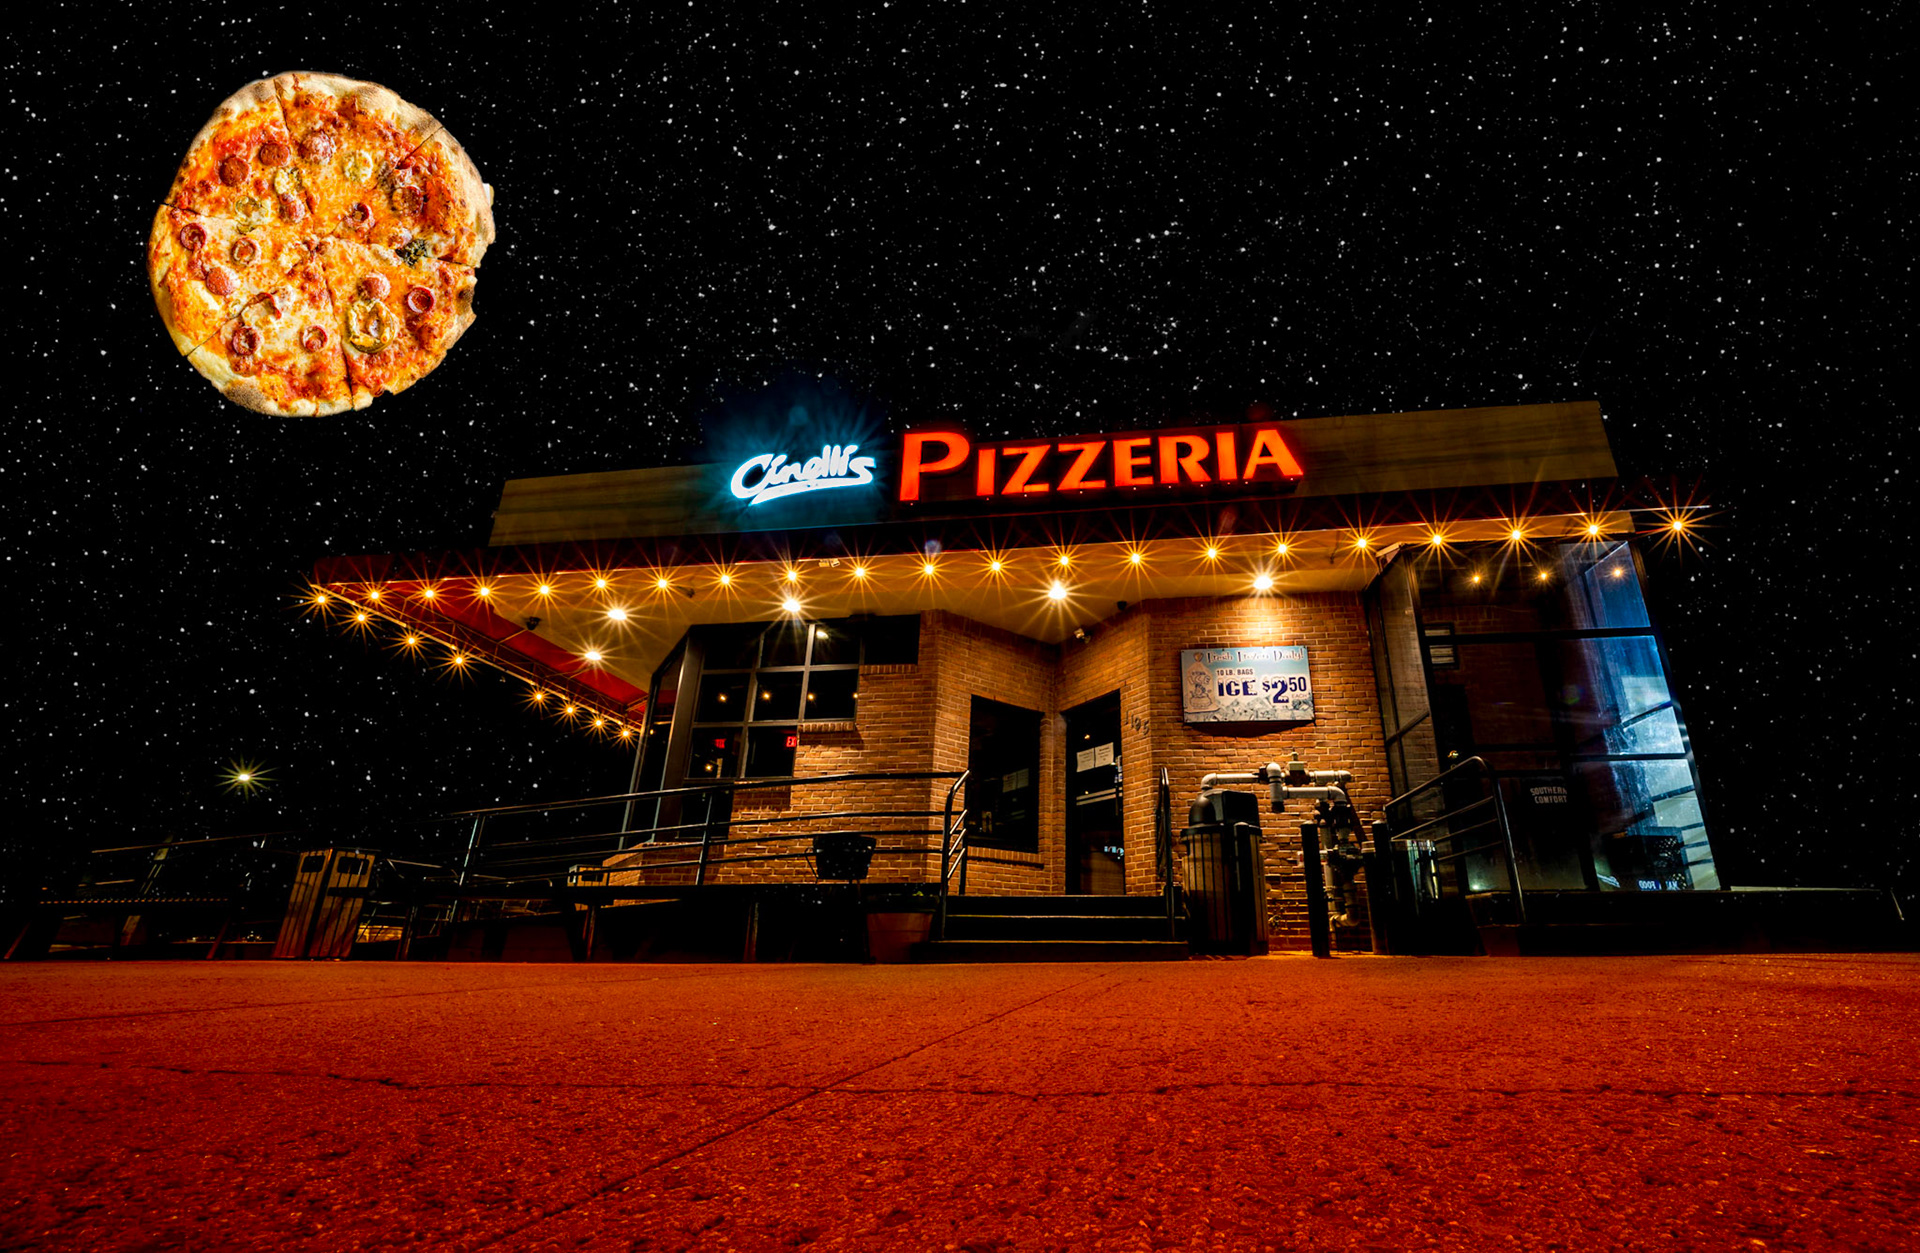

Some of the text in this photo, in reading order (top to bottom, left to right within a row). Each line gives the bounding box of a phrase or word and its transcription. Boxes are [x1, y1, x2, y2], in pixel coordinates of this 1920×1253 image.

[900, 429, 1304, 501] PIZZERIA
[1237, 668, 1254, 676] BAGS
[1217, 678, 1258, 697] ICE
[1534, 795, 1567, 804] COMFORT
